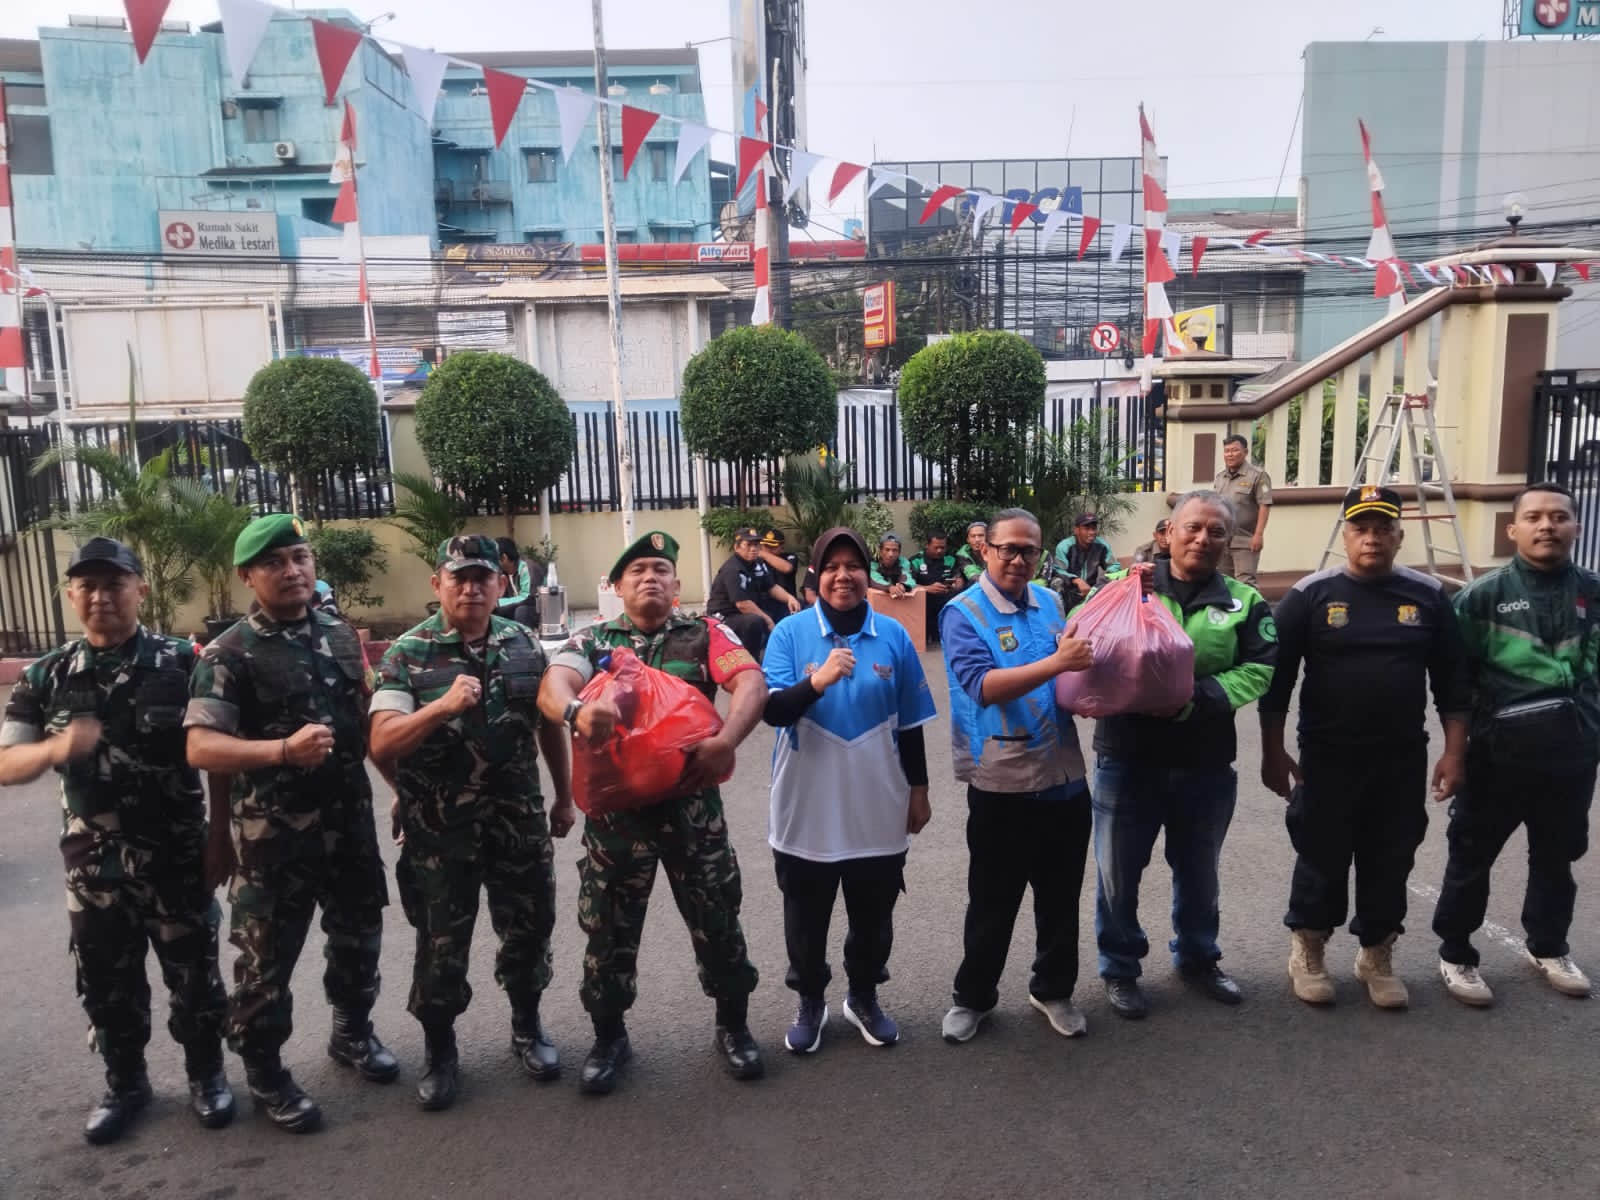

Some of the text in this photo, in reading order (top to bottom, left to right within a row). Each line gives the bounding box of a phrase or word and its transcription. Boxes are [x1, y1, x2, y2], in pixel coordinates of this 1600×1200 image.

[1000, 186, 1083, 224] BCA
[198, 222, 259, 233] Rumah Sakit
[199, 236, 275, 251] Medika Lestari
[700, 246, 749, 257] Alfamart
[1099, 329, 1112, 347] P
[1497, 598, 1530, 614] Grab
